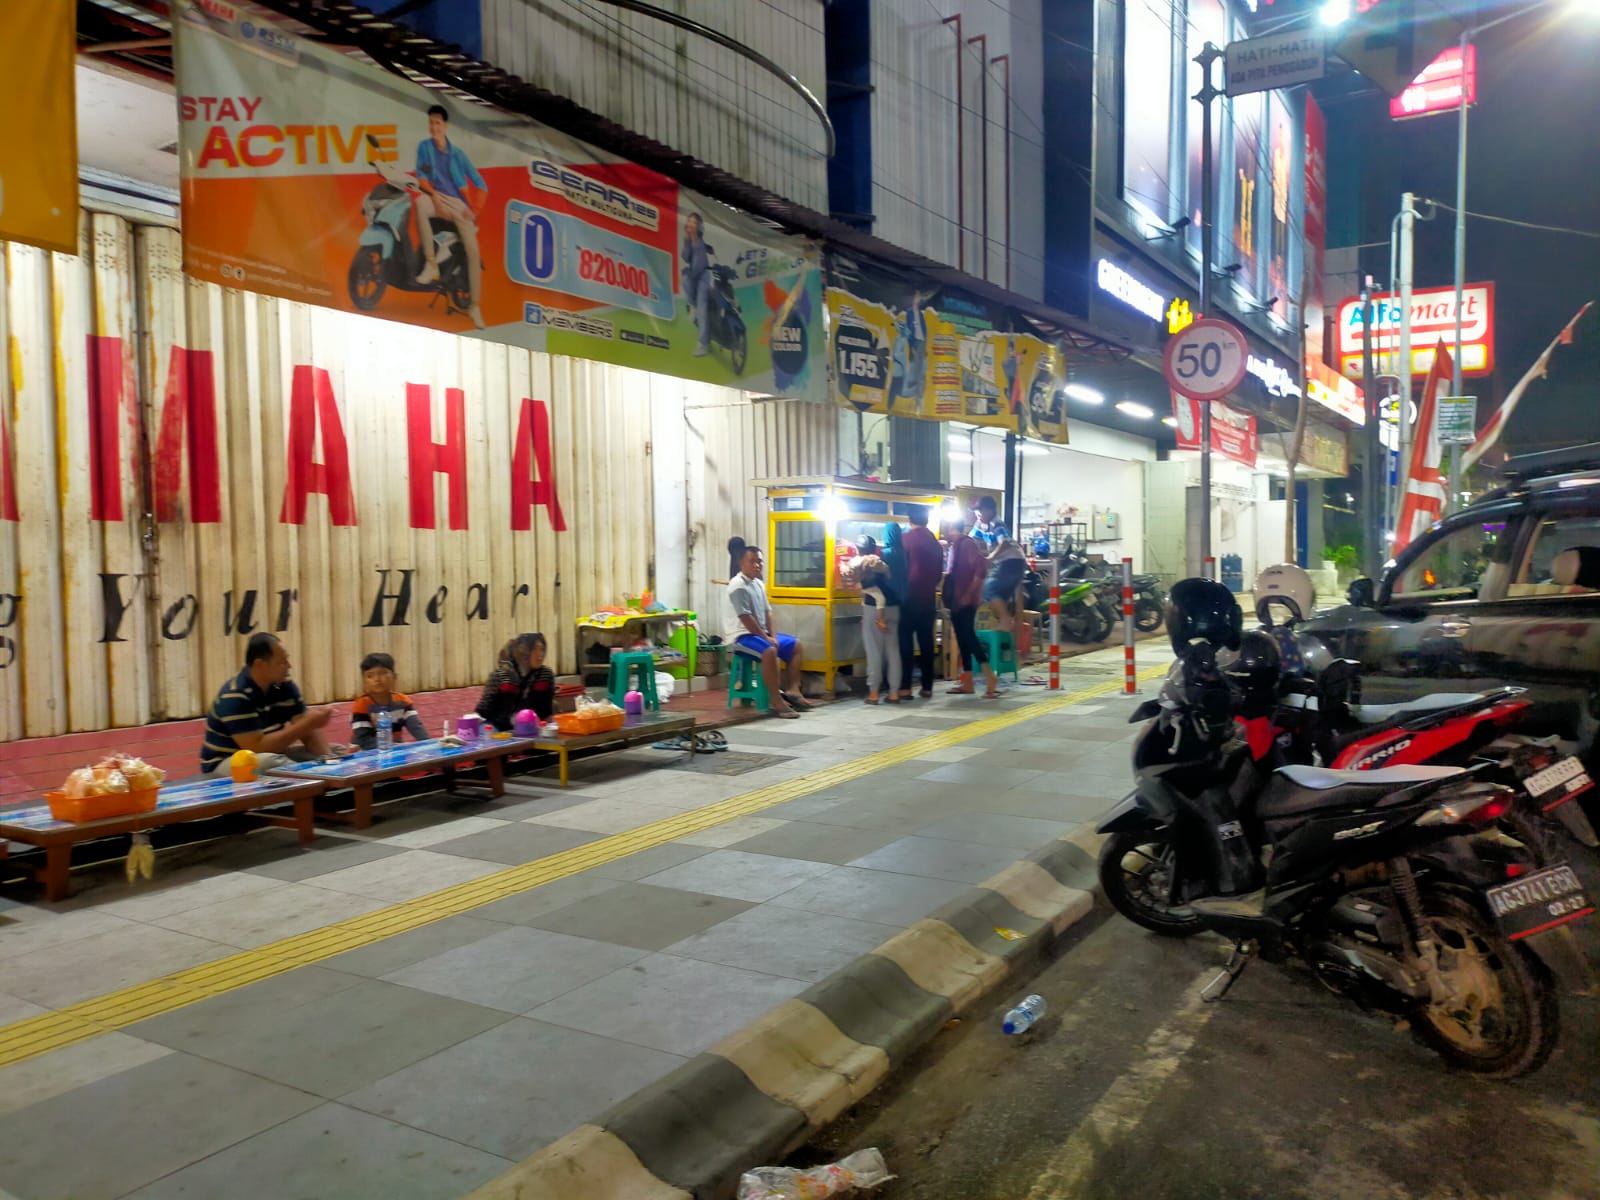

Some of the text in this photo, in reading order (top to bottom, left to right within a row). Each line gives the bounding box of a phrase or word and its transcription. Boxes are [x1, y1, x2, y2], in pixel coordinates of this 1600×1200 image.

[1237, 40, 1315, 64] HATI-HATI
[180, 96, 264, 122] STAY
[197, 124, 399, 169] ACTIVE
[578, 248, 651, 298] 820.000
[541, 314, 614, 338] MEMBERS
[1176, 342, 1221, 378] 50
[0, 334, 568, 532] MAHA
[96, 573, 298, 641] Your
[362, 569, 561, 627] Hear
